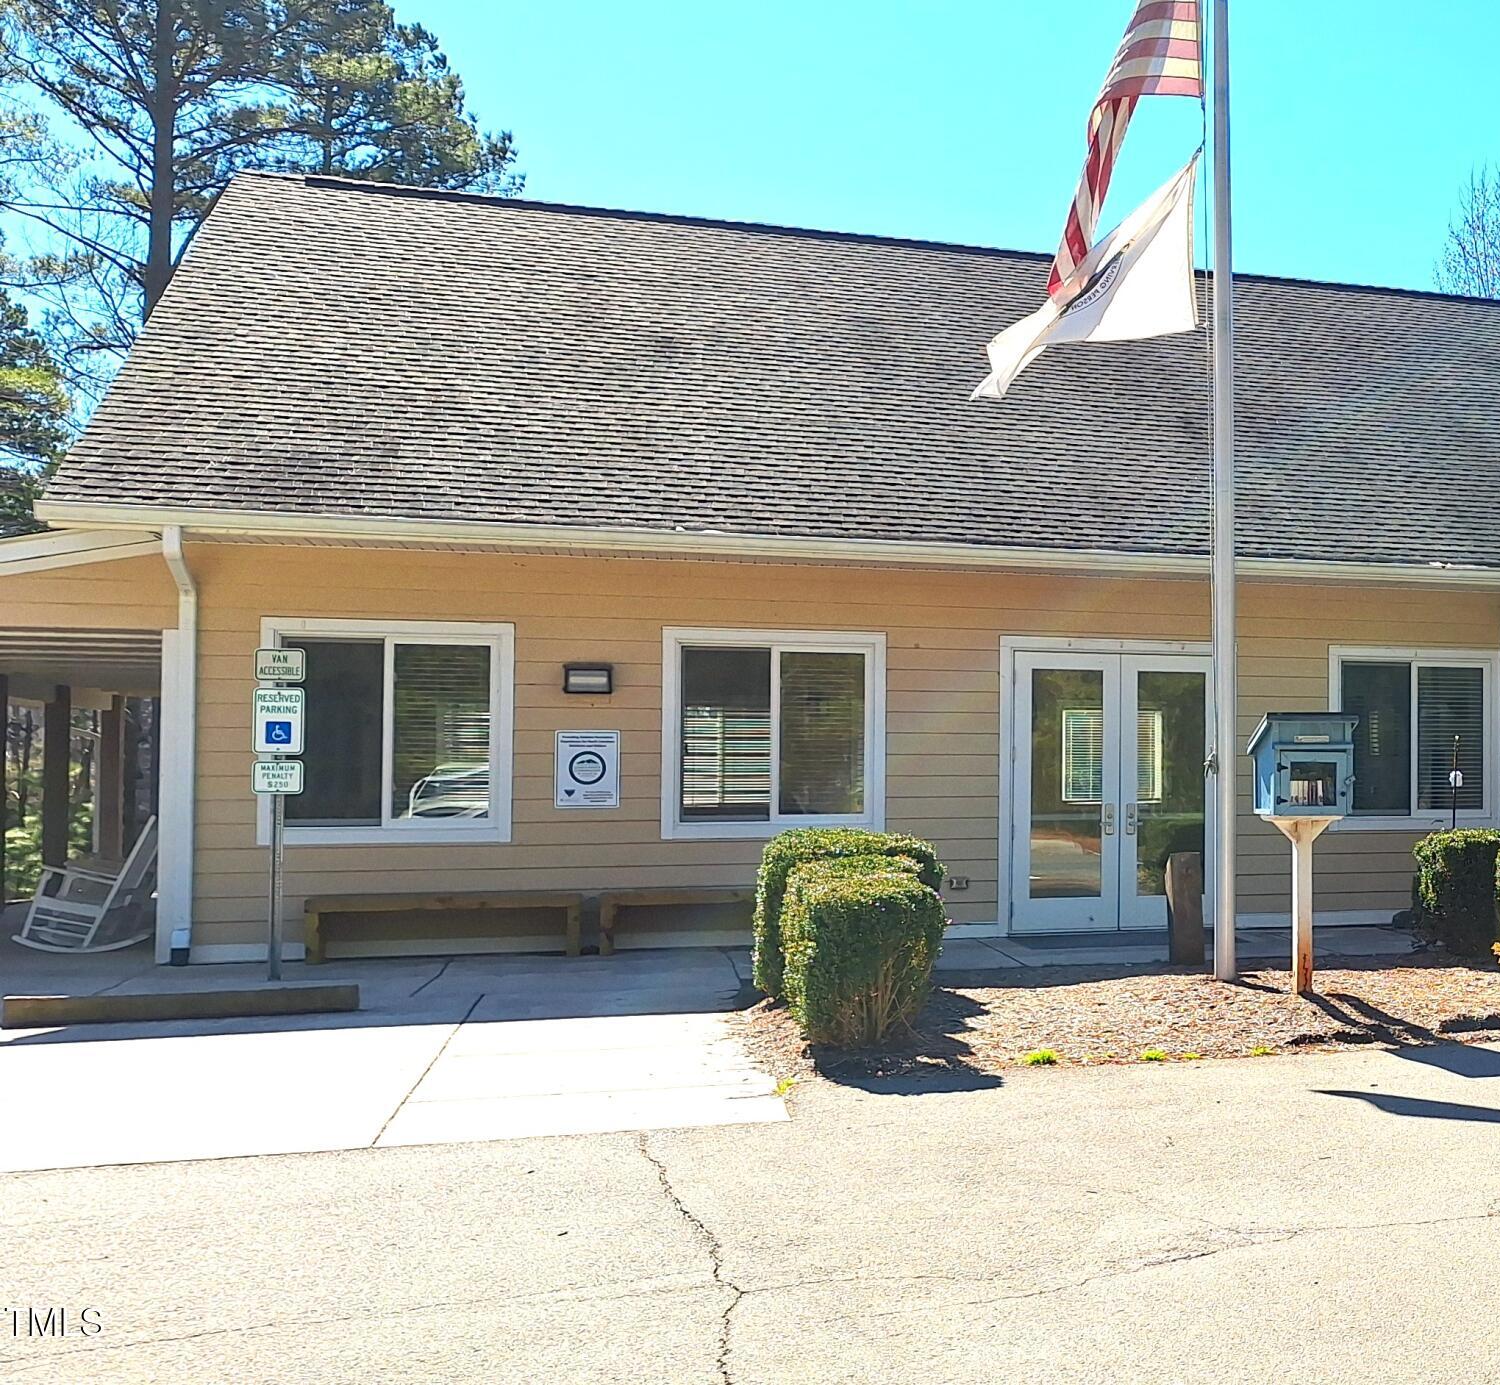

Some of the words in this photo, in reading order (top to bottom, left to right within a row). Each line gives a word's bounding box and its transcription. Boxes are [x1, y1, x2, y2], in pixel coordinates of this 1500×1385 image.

[271, 654, 288, 664] VAN
[259, 666, 300, 676] ACCESSIBLE
[257, 693, 301, 704] RESERVED
[260, 705, 298, 715] PARKING
[260, 764, 295, 772] MAXIMUM
[262, 772, 293, 780] PENALTY
[267, 781, 289, 789] $250
